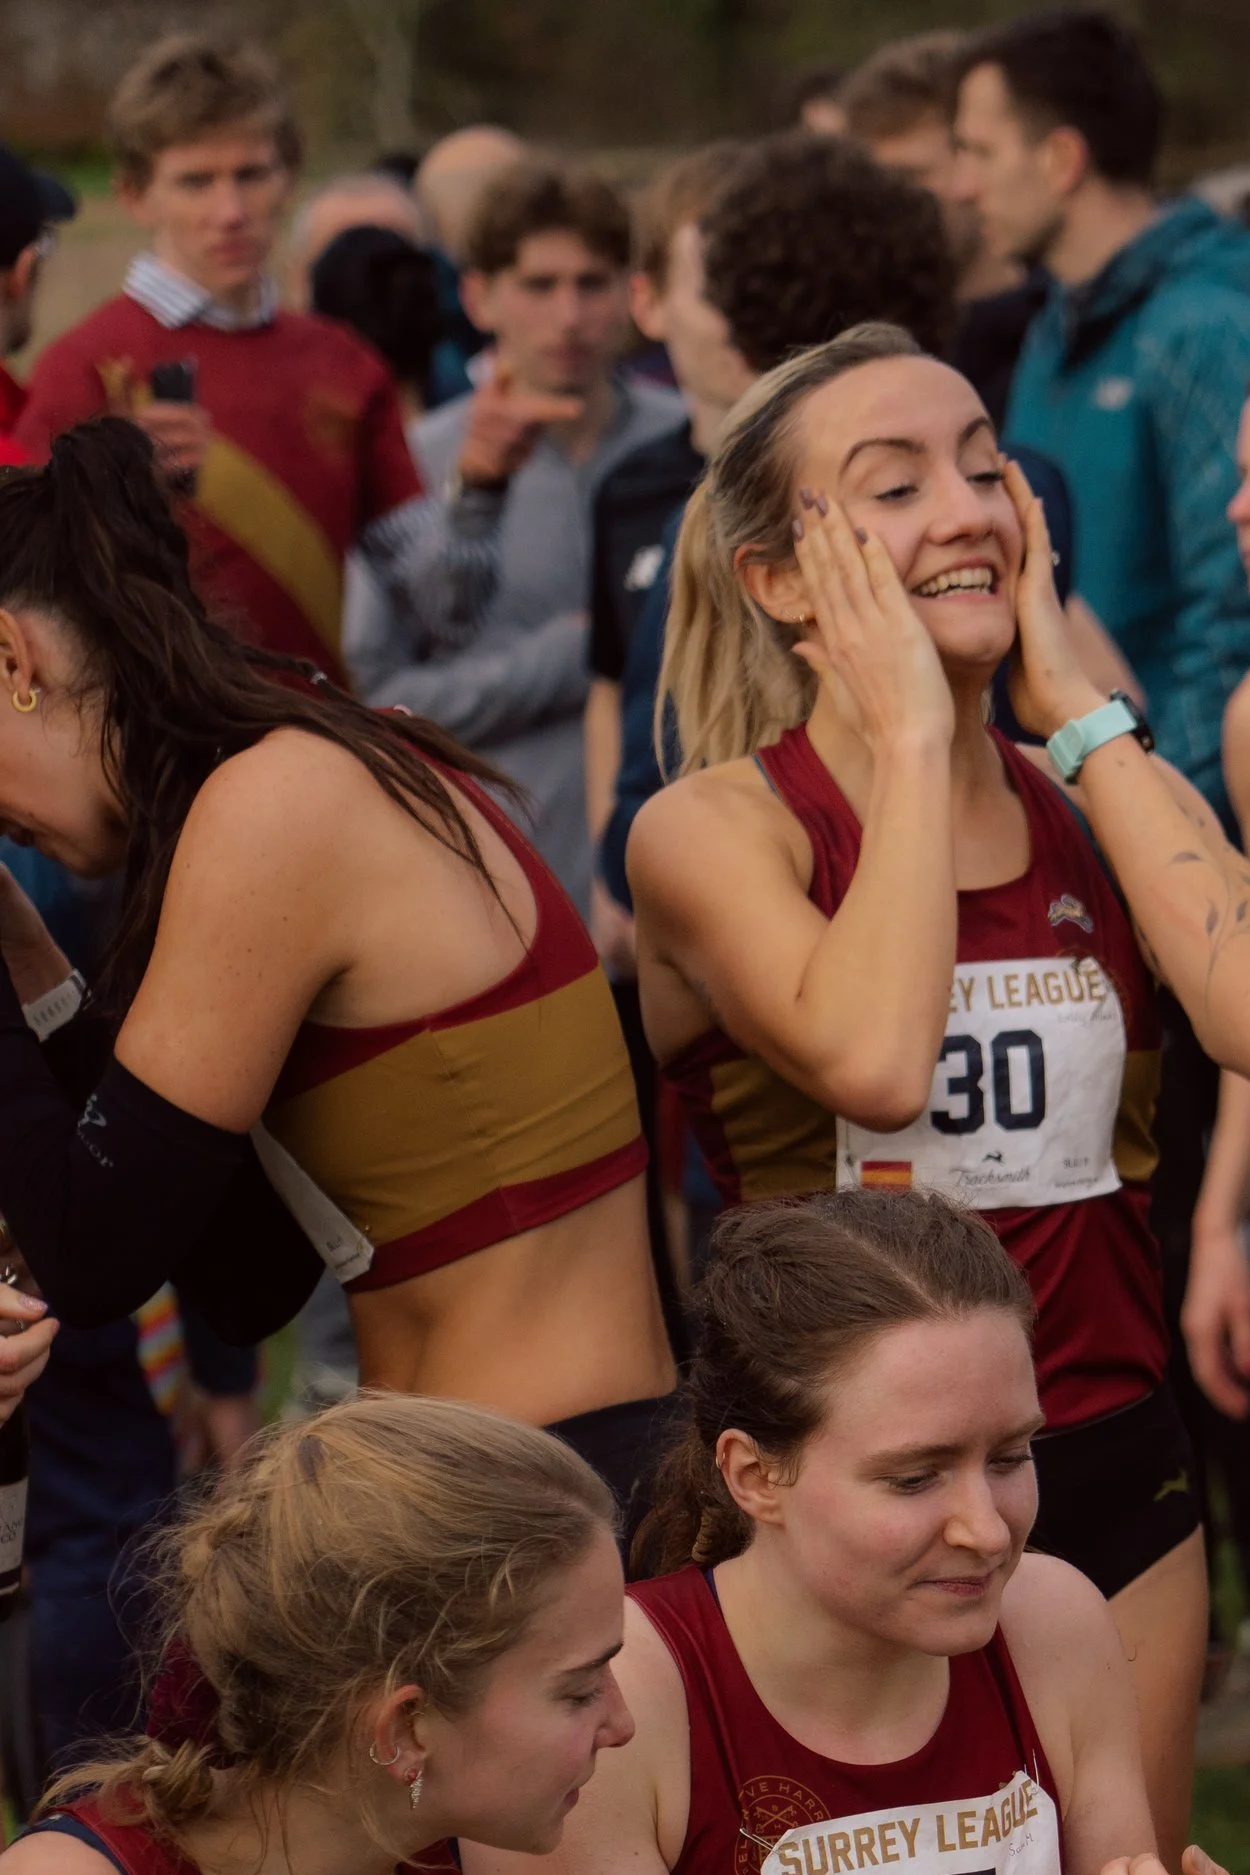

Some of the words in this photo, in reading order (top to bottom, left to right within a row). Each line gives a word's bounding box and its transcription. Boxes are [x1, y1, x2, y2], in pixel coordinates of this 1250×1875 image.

[987, 967, 1106, 1009] LEAGUE
[930, 1030, 1047, 1135] 30
[949, 1166, 1030, 1187] Tracksmith
[779, 1783, 824, 1821] HARR
[936, 1779, 1038, 1853] LEAGUE
